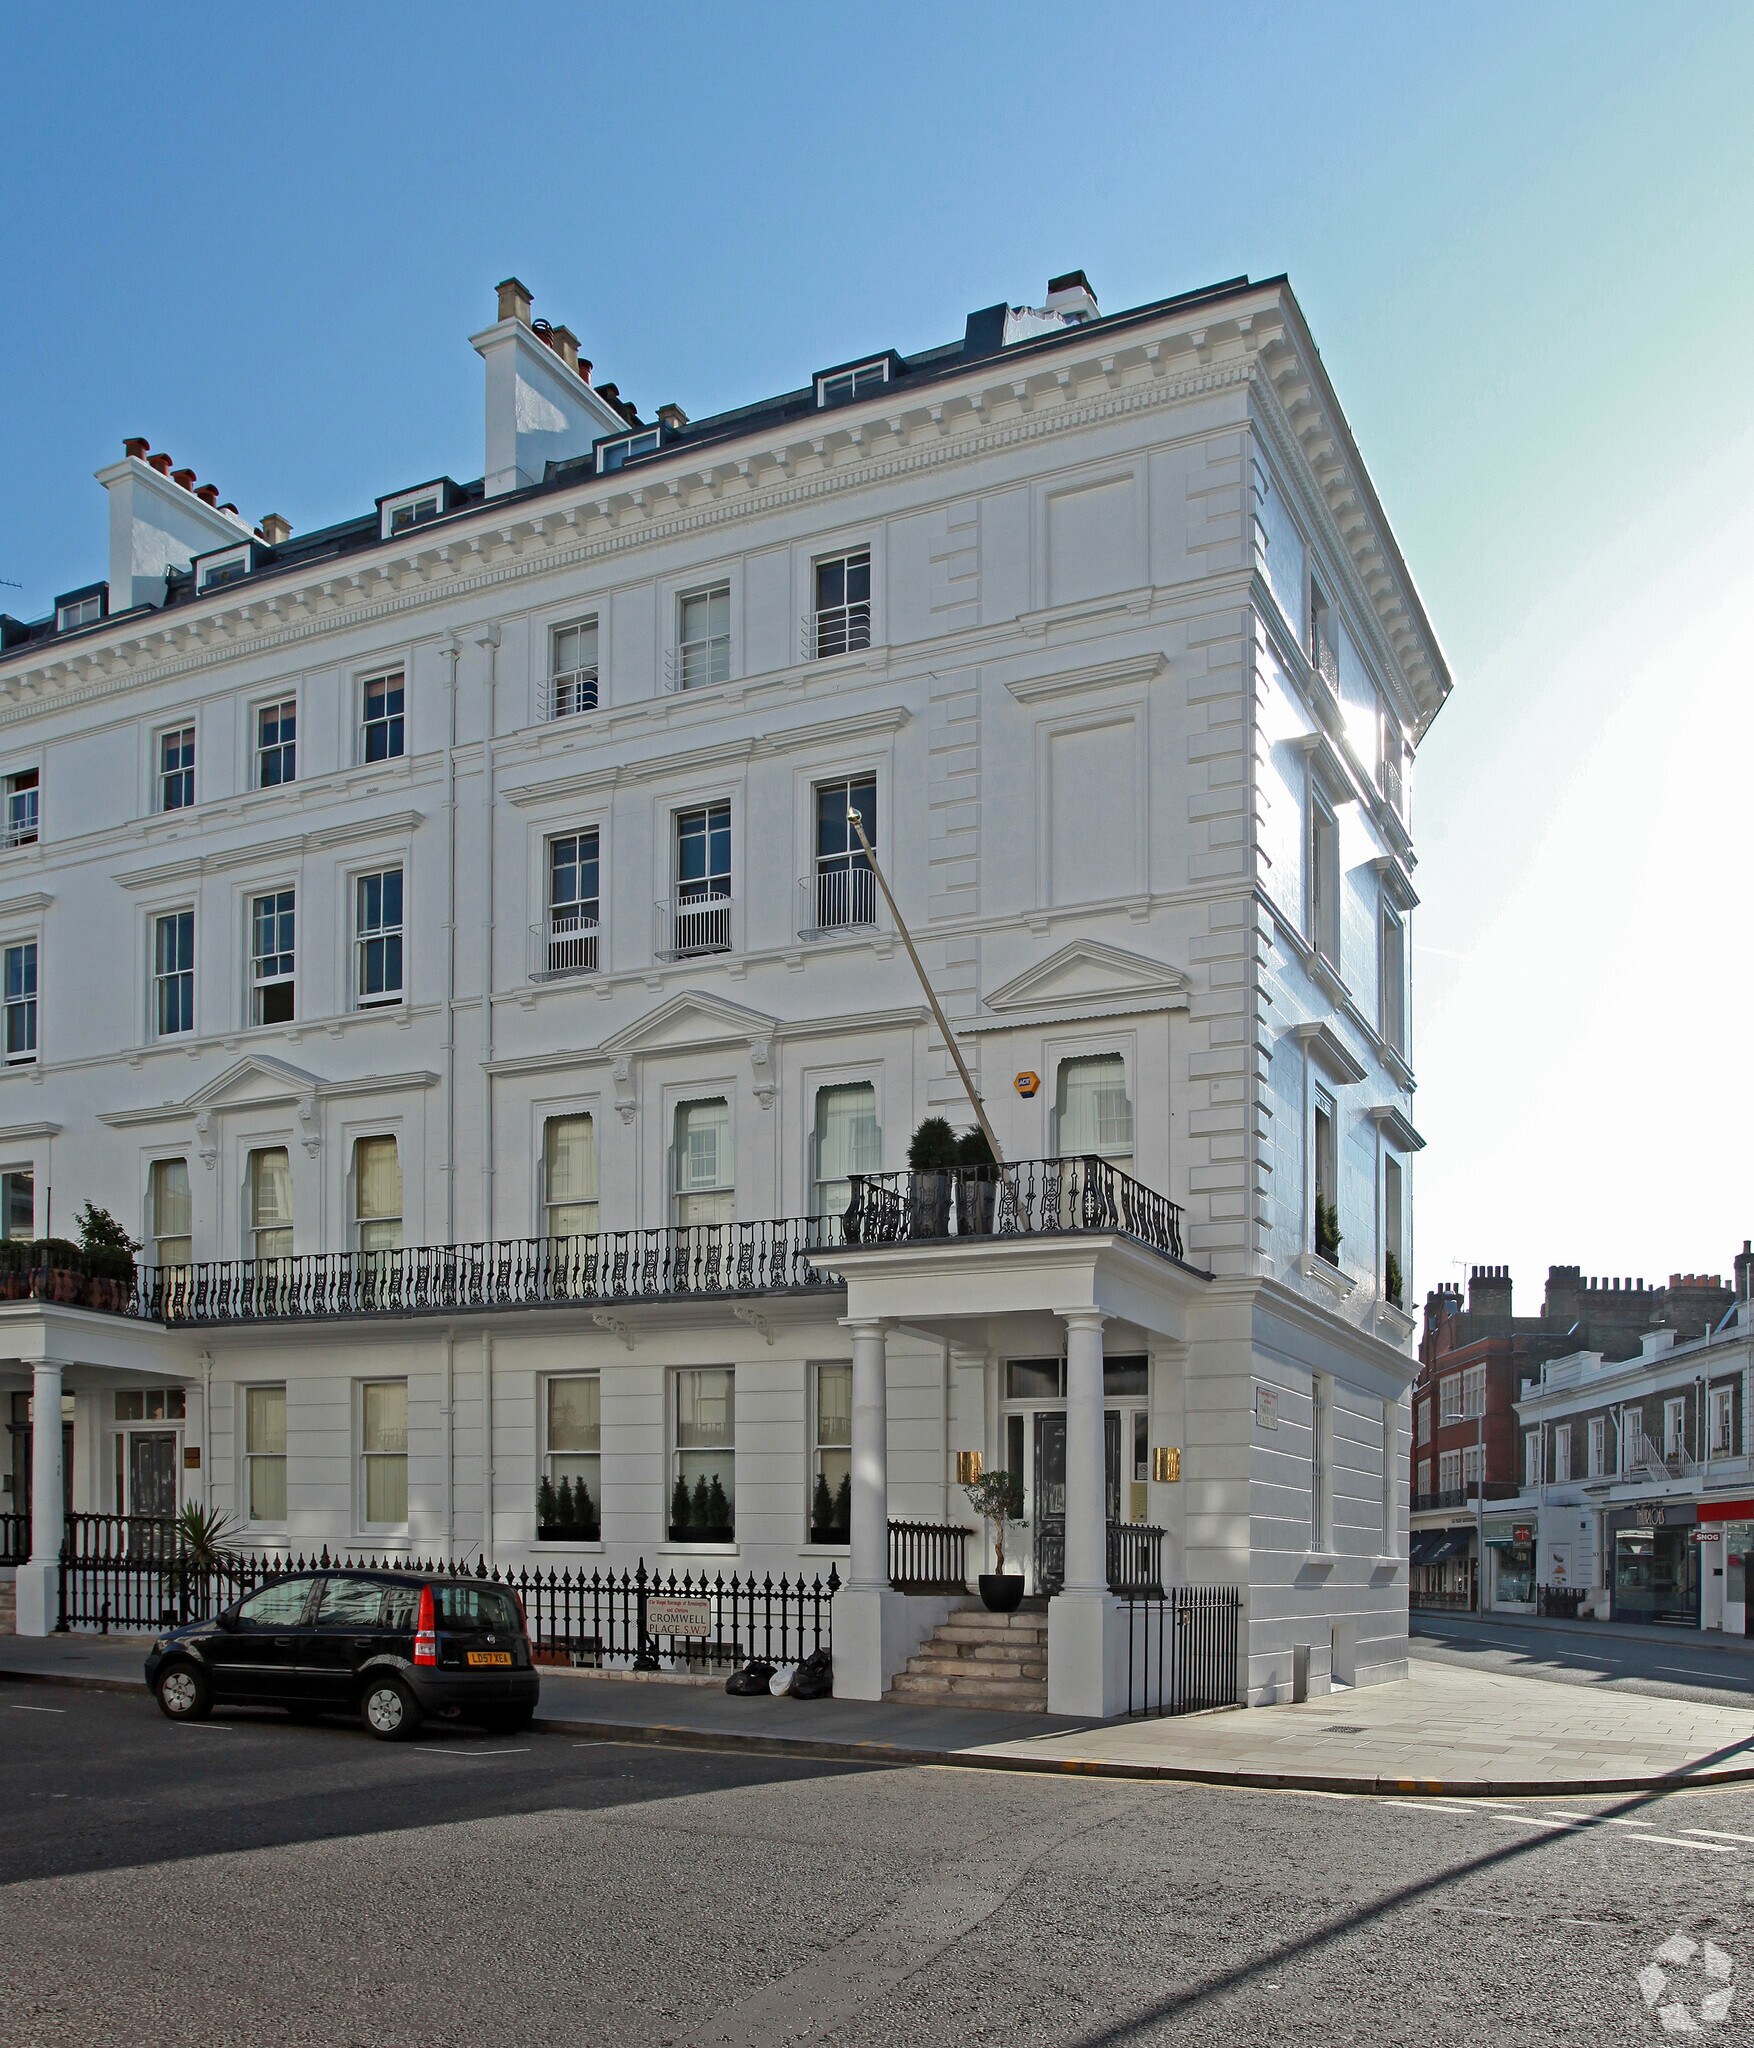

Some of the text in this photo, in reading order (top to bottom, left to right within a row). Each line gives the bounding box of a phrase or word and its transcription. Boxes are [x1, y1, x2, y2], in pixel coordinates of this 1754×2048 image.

[1696, 1533, 1719, 1541] SNOG
[650, 1613, 706, 1624] CROMWELL
[684, 1625, 707, 1635] S.W.7
[471, 1653, 509, 1663] LD57 XEA
